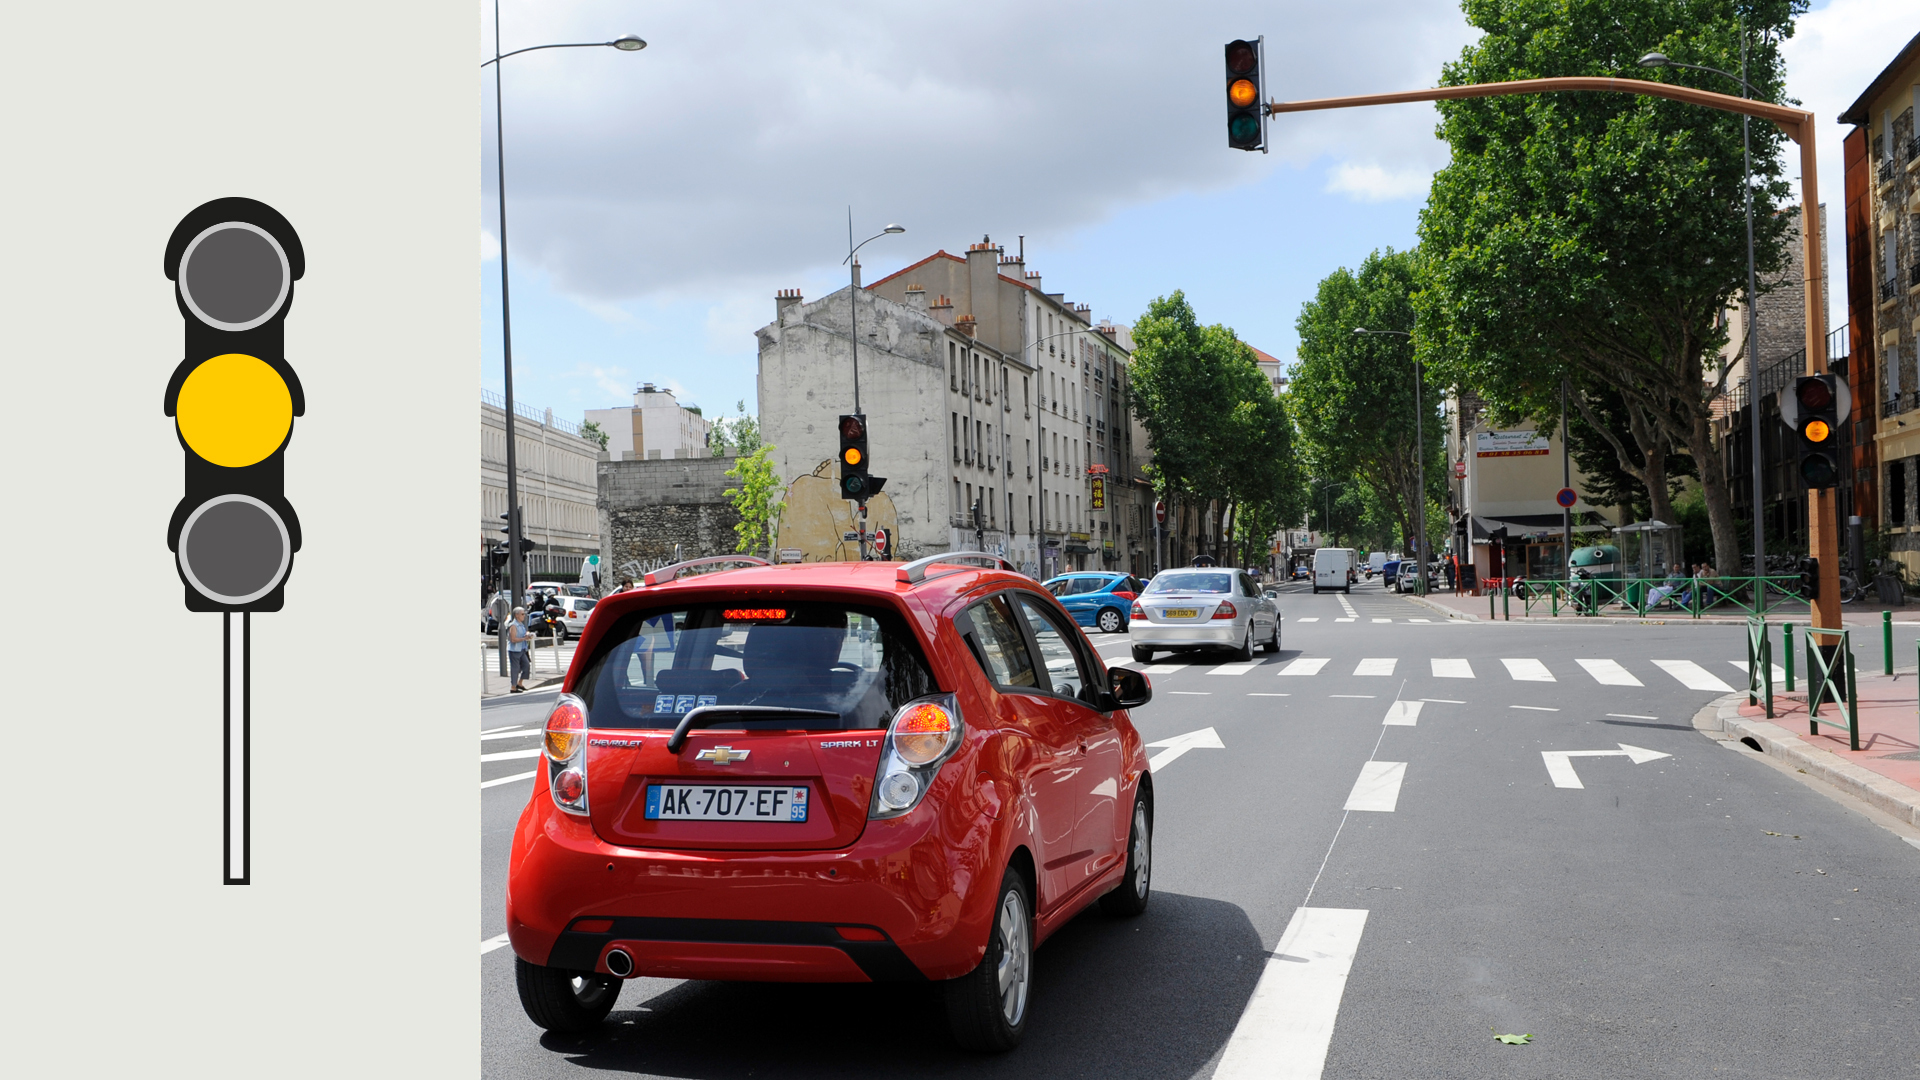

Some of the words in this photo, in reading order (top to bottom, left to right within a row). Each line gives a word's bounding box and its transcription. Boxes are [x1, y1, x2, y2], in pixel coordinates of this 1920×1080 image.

[589, 739, 643, 748] CHEVROLET
[820, 740, 862, 749] SPARK
[866, 739, 879, 748] LT
[791, 805, 806, 819] 95
